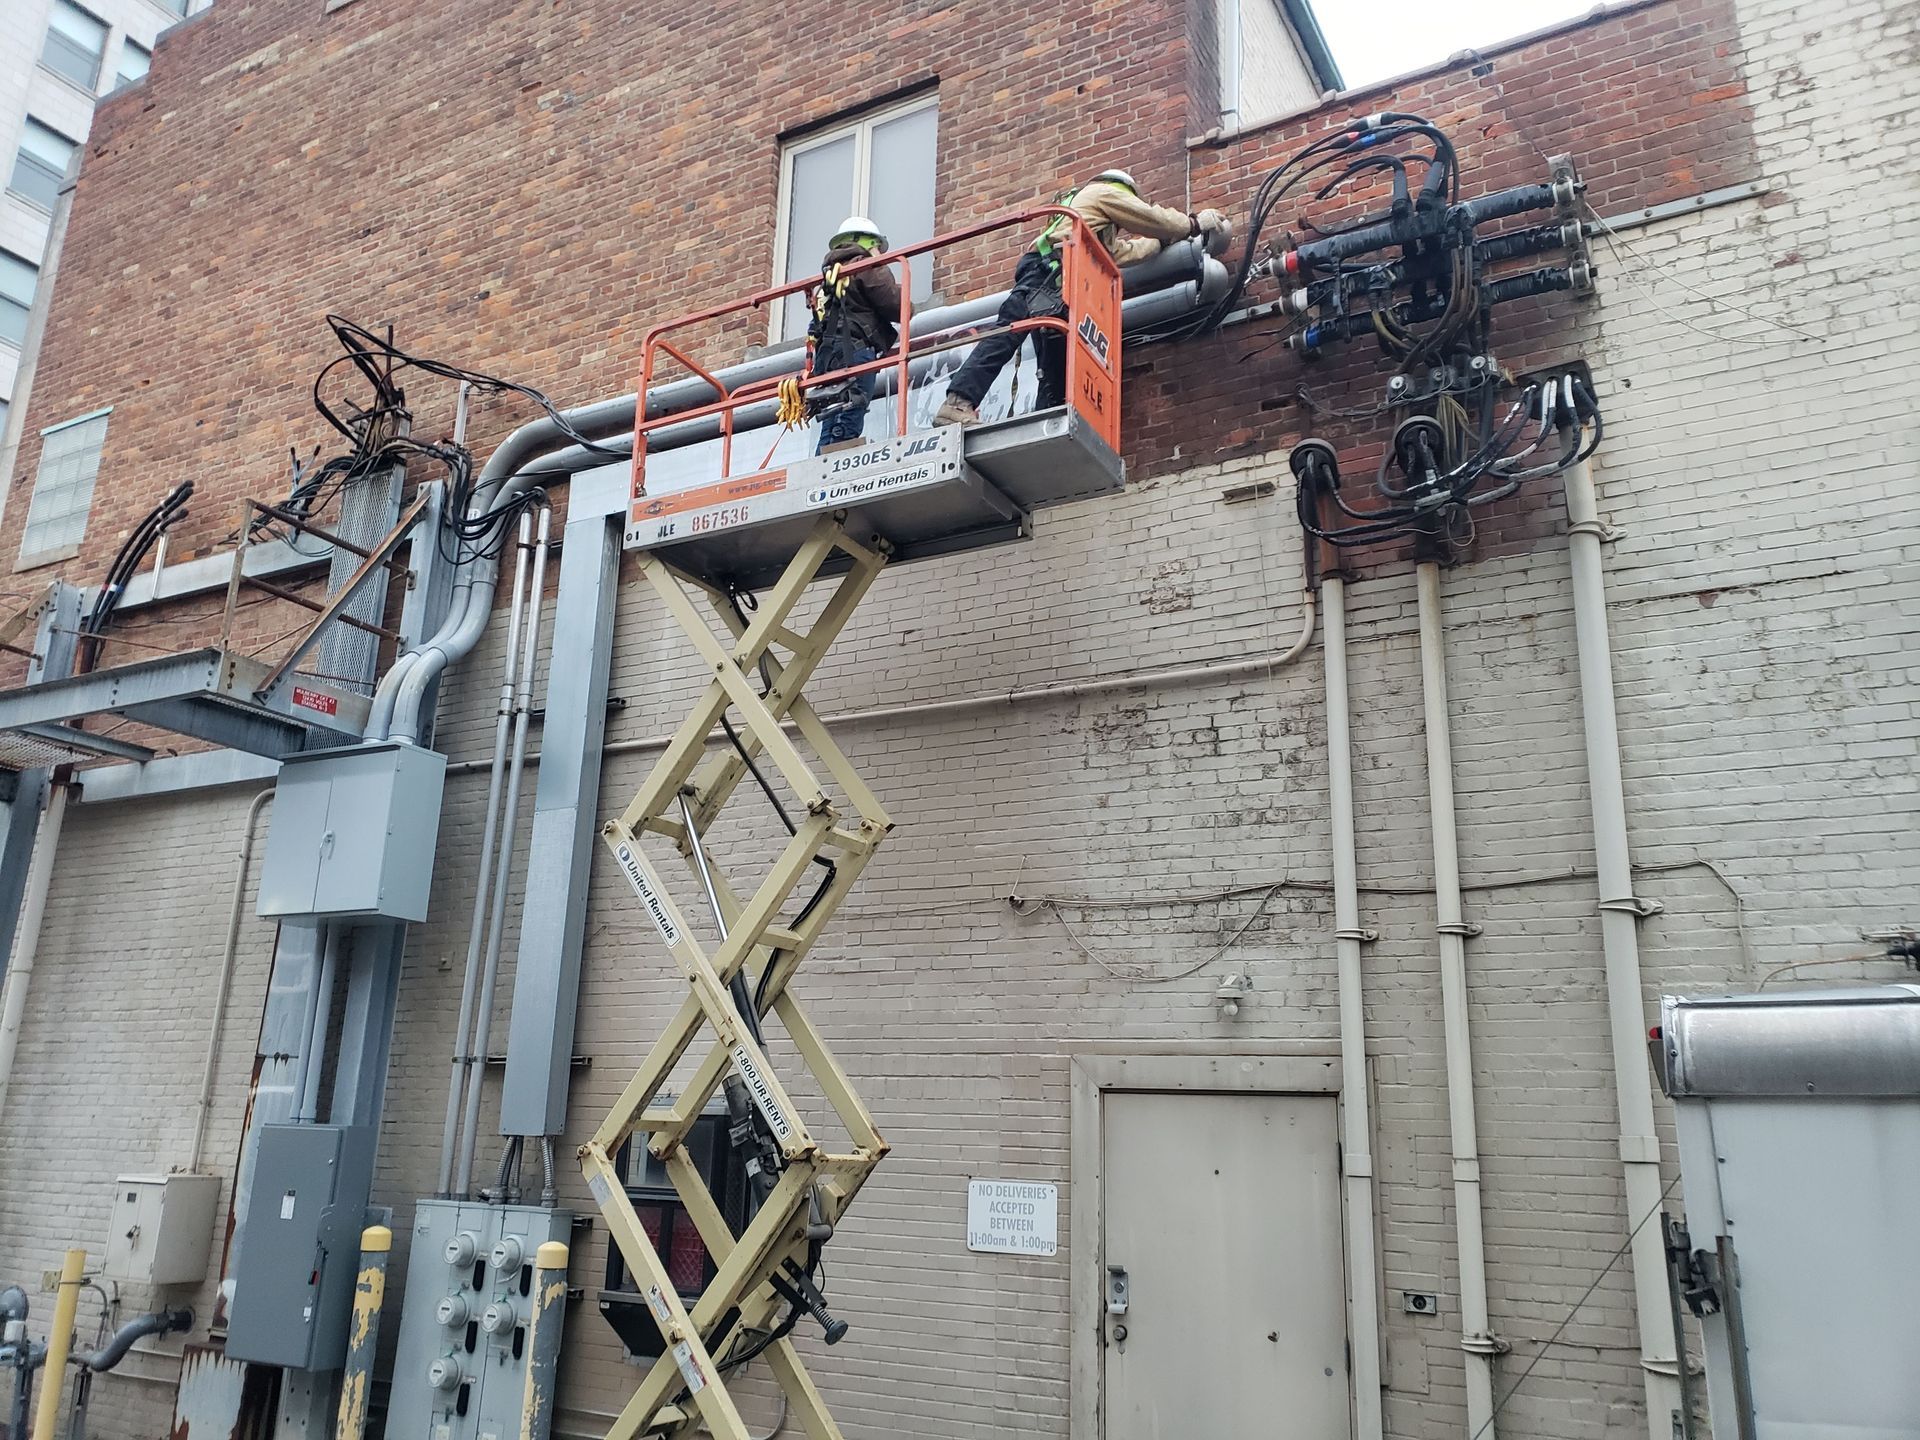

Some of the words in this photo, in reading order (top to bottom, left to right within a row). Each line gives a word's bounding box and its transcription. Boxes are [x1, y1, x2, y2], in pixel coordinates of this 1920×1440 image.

[1078, 314, 1109, 361] JLG
[832, 448, 891, 473] 1930ES
[903, 436, 940, 457] JLG
[657, 524, 675, 538] JLE
[692, 506, 749, 532] 867536
[627, 861, 652, 898] United
[648, 897, 675, 939] Rentals
[736, 1049, 789, 1135] 1-800-UR-RENTS
[979, 1184, 993, 1197] NO
[996, 1185, 1047, 1200] DELIVERIES
[989, 1201, 1035, 1215] ACCEPTED
[990, 1217, 1034, 1232] BETWEEN
[970, 1232, 1007, 1247] 11:00am
[1010, 1235, 1017, 1247] &
[1021, 1235, 1056, 1252] 1:00pm
